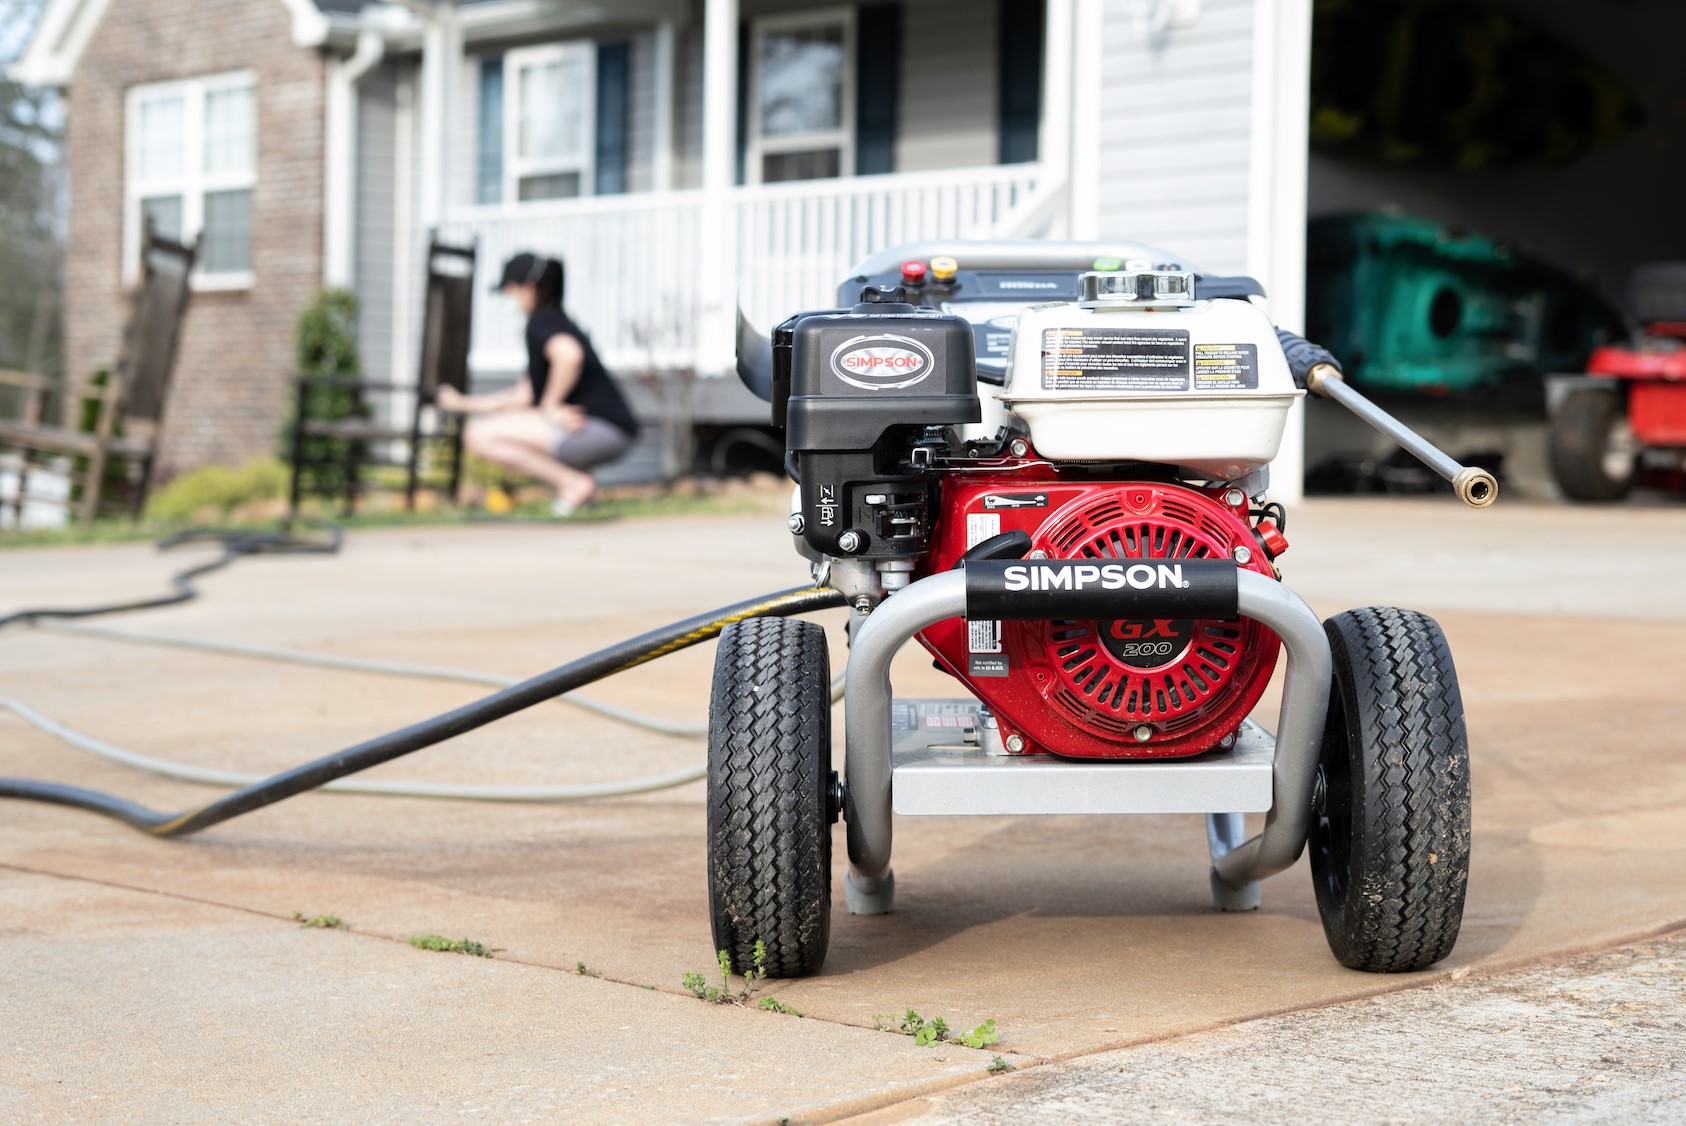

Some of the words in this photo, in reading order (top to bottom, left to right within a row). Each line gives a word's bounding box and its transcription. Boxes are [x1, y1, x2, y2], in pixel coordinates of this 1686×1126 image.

[847, 357, 916, 368] SIMPSON
[1111, 619, 1179, 639] GX
[1123, 642, 1172, 656] 200
